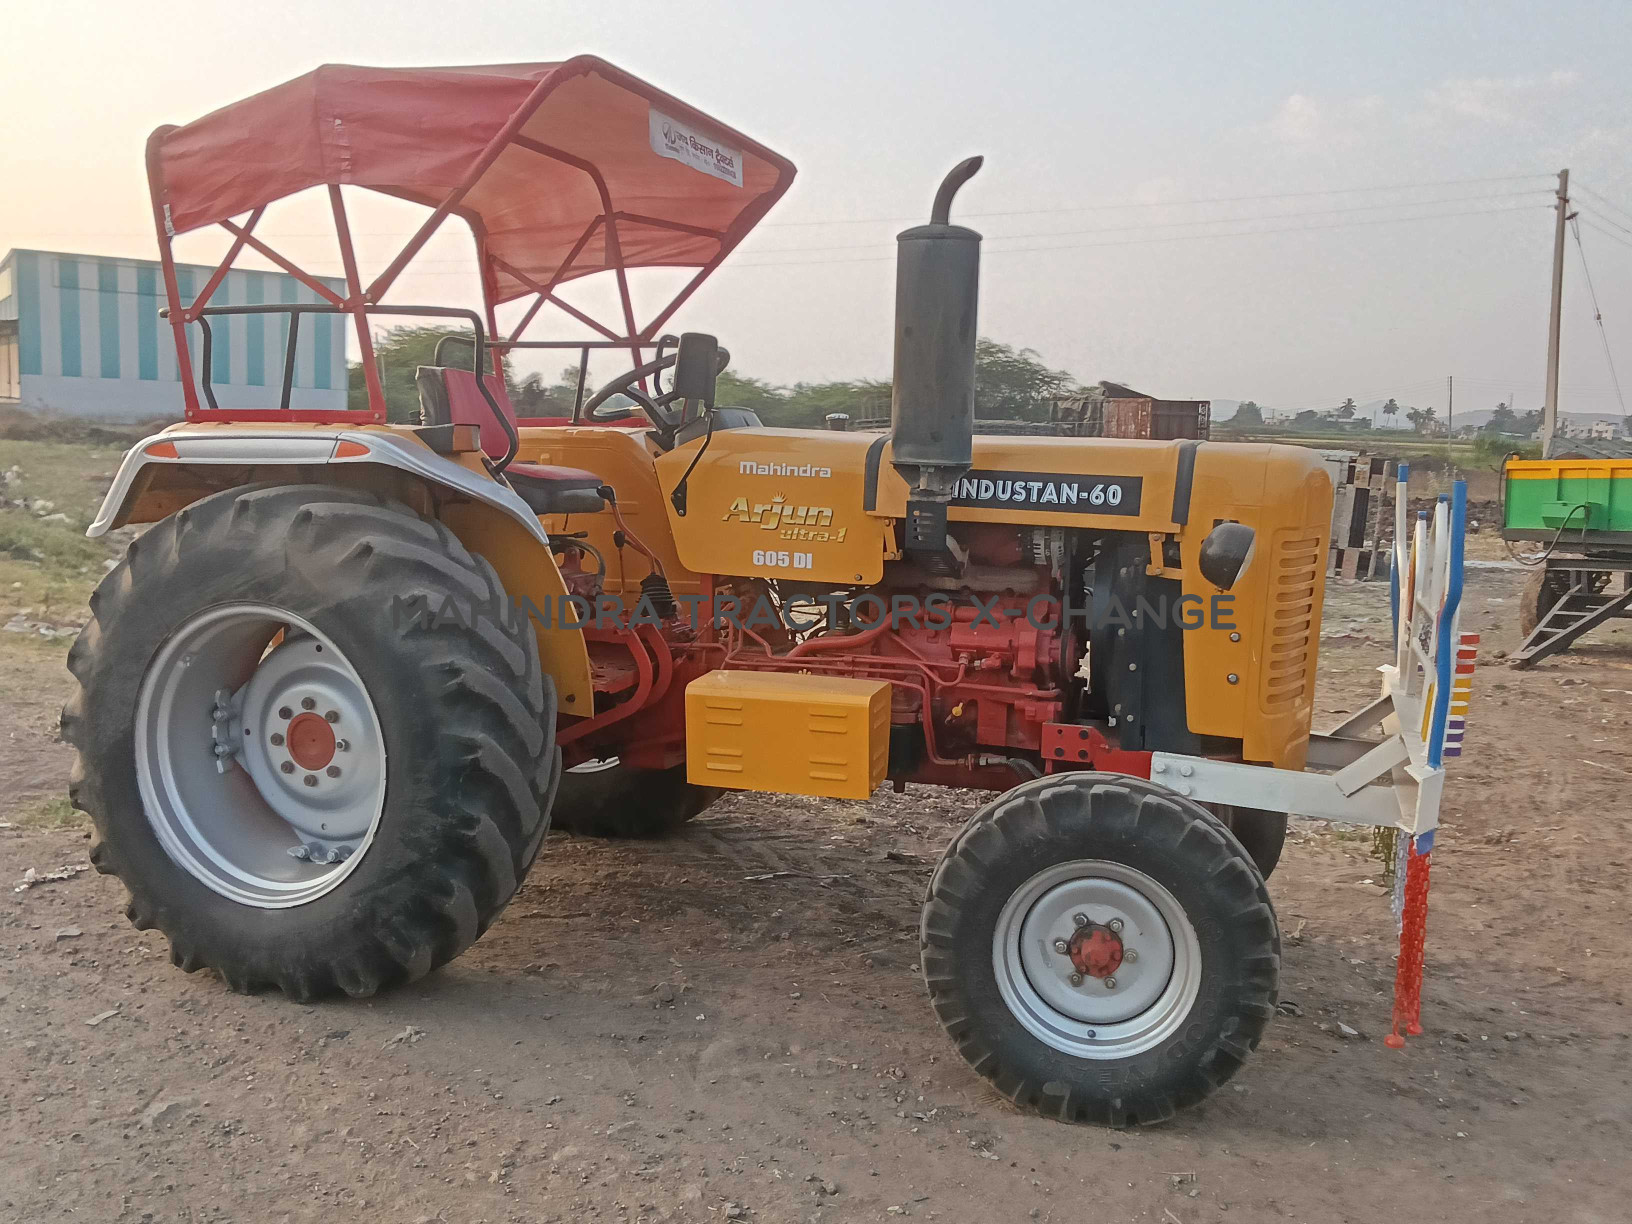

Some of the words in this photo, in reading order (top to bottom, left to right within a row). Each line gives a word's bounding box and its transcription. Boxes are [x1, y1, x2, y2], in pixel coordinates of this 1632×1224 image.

[739, 461, 832, 478] Mahindra
[722, 491, 833, 530] Arjun
[780, 527, 848, 543] ultra-1
[752, 549, 790, 567] 605
[793, 552, 813, 569] DI
